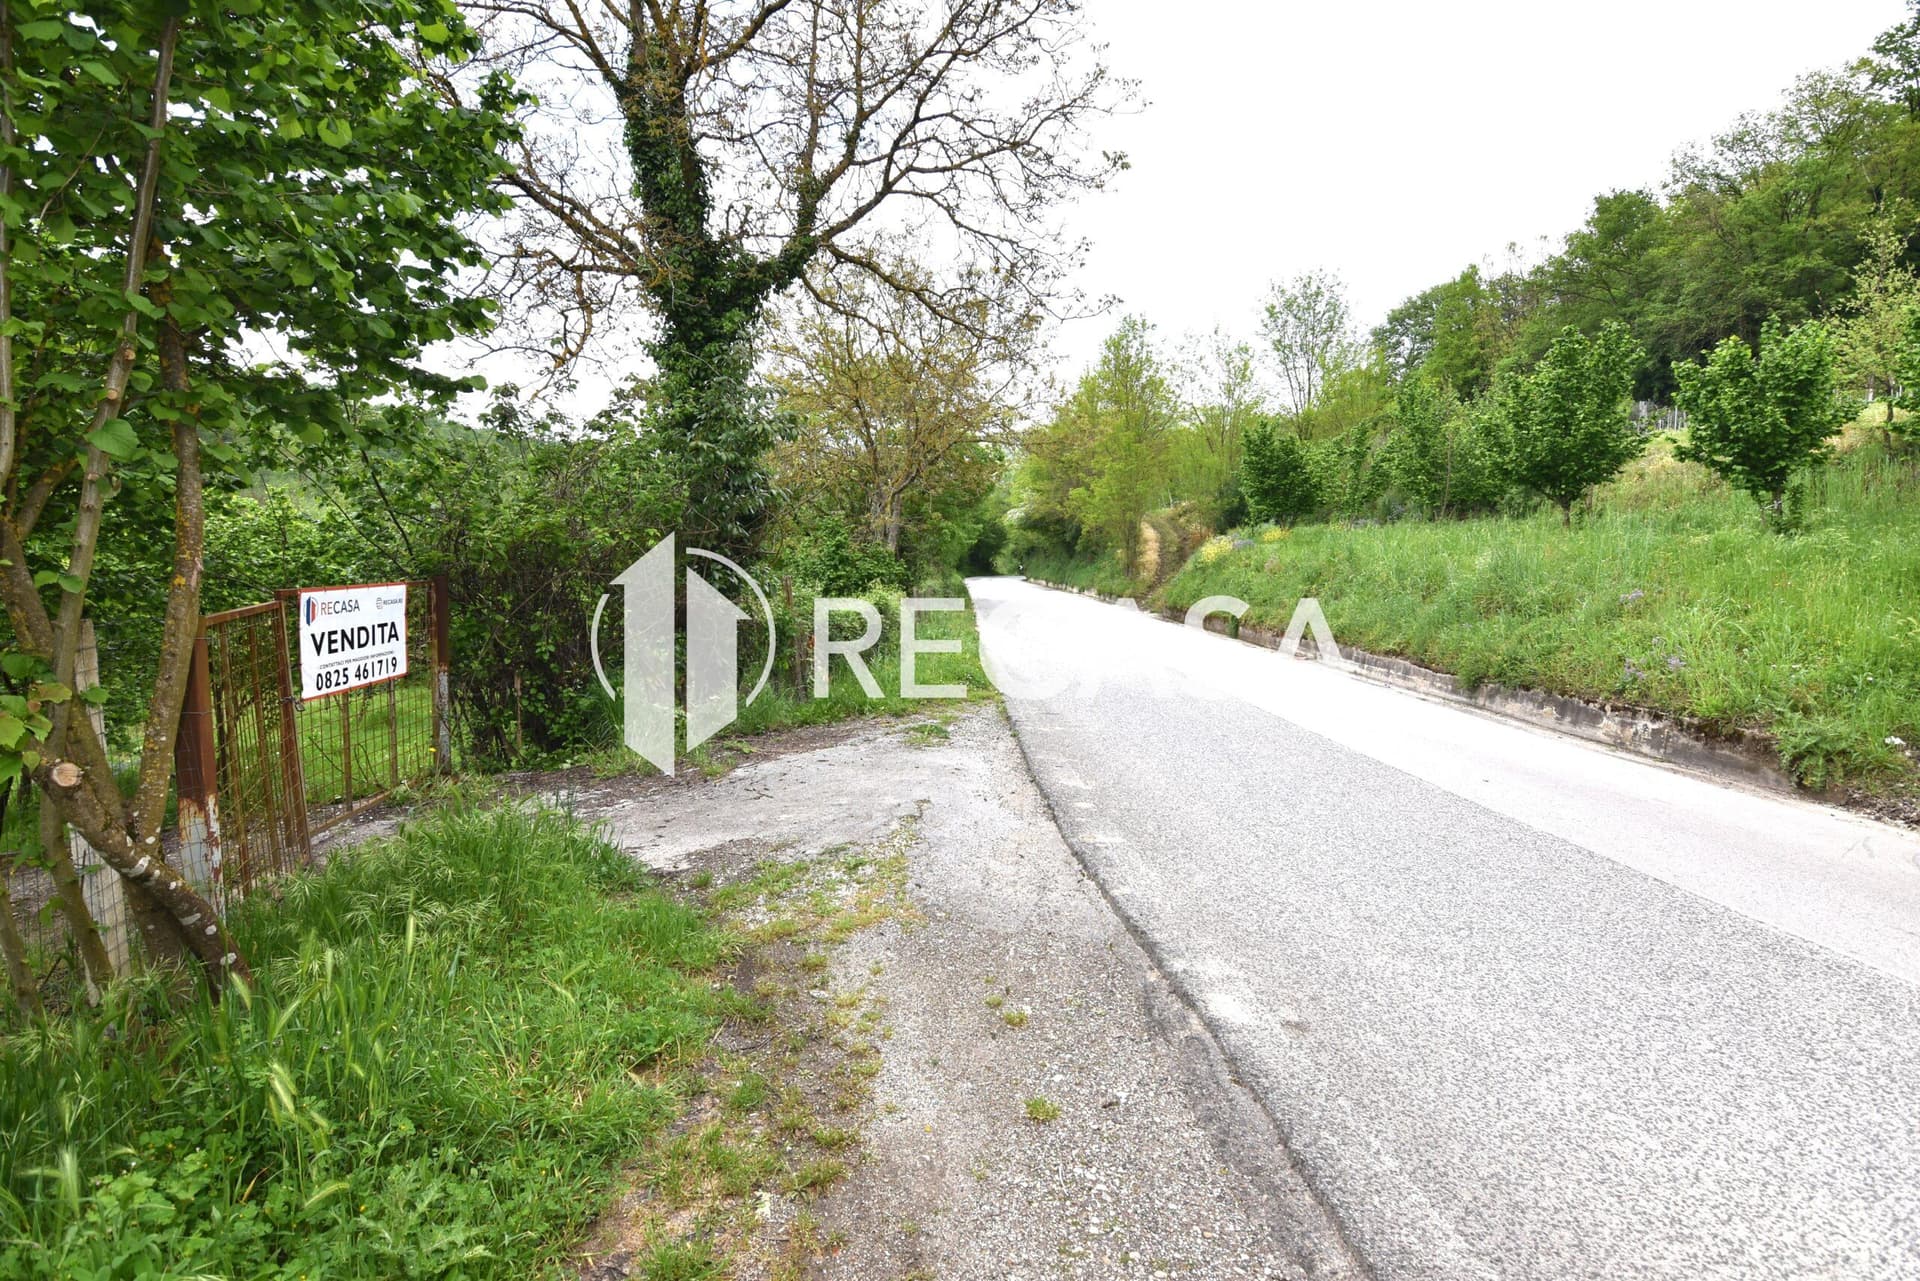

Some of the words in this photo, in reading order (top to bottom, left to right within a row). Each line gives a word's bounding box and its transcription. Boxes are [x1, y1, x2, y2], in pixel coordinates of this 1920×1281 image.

[321, 600, 360, 615] RECASA
[311, 621, 399, 656] VENDITA
[316, 667, 349, 691] 0825
[355, 656, 397, 681] 461719
